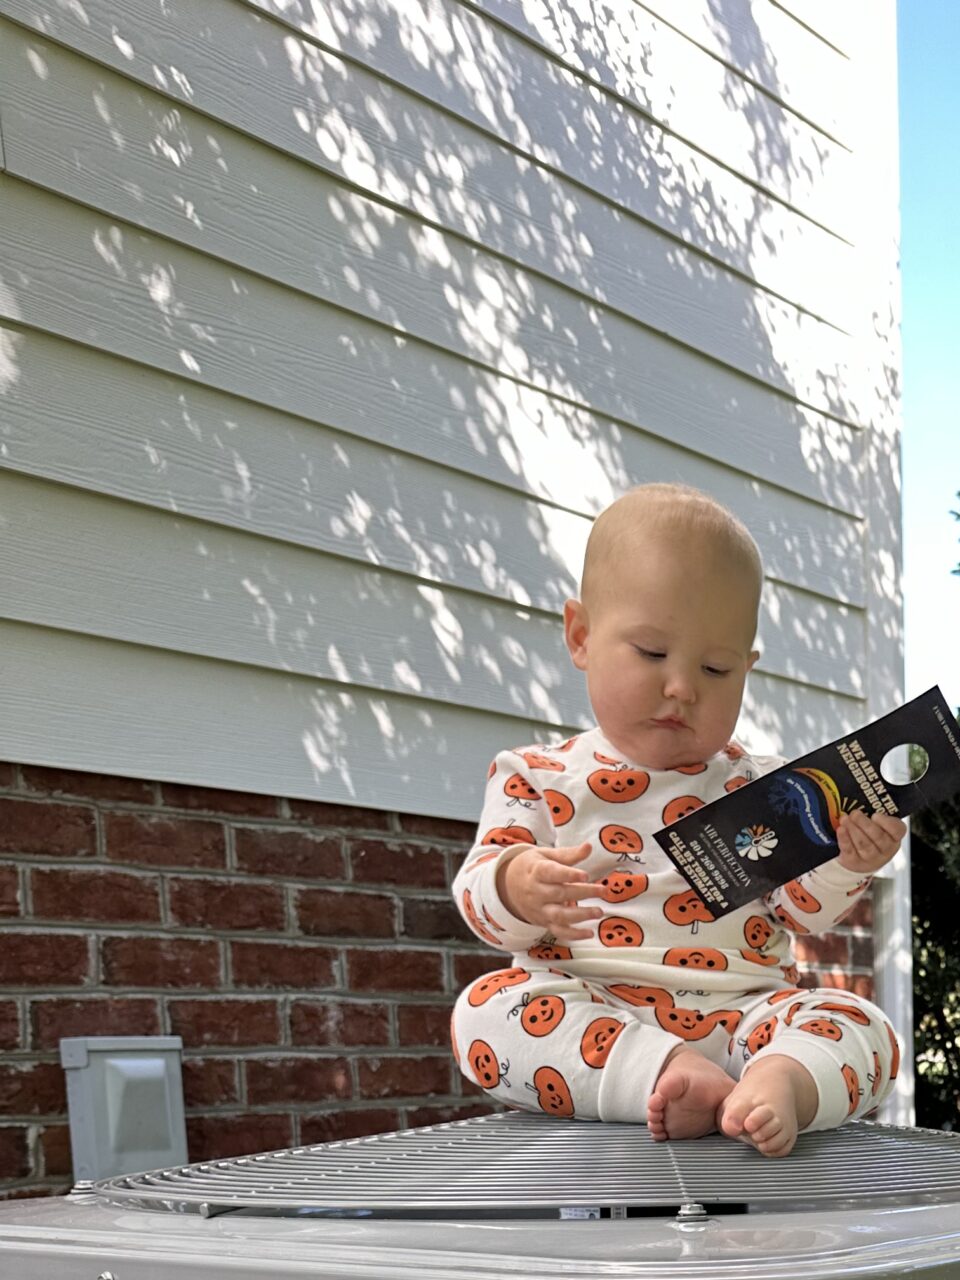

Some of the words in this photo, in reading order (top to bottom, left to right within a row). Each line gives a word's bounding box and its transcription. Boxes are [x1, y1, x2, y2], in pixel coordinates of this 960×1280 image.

[837, 742, 887, 818] NEIGHBORHOO
[848, 739, 865, 760] WE
[859, 757, 878, 781] ARE
[872, 779, 887, 795] IN
[880, 793, 898, 815] THE
[669, 831, 687, 852] CALL
[684, 850, 695, 862] US
[692, 861, 714, 888] TODAY
[710, 886, 724, 902] FOR
[684, 865, 716, 903] ESTIMATE
[700, 855, 715, 870] 269
[704, 824, 718, 839] AIR
[713, 838, 751, 887] PERFECTION
